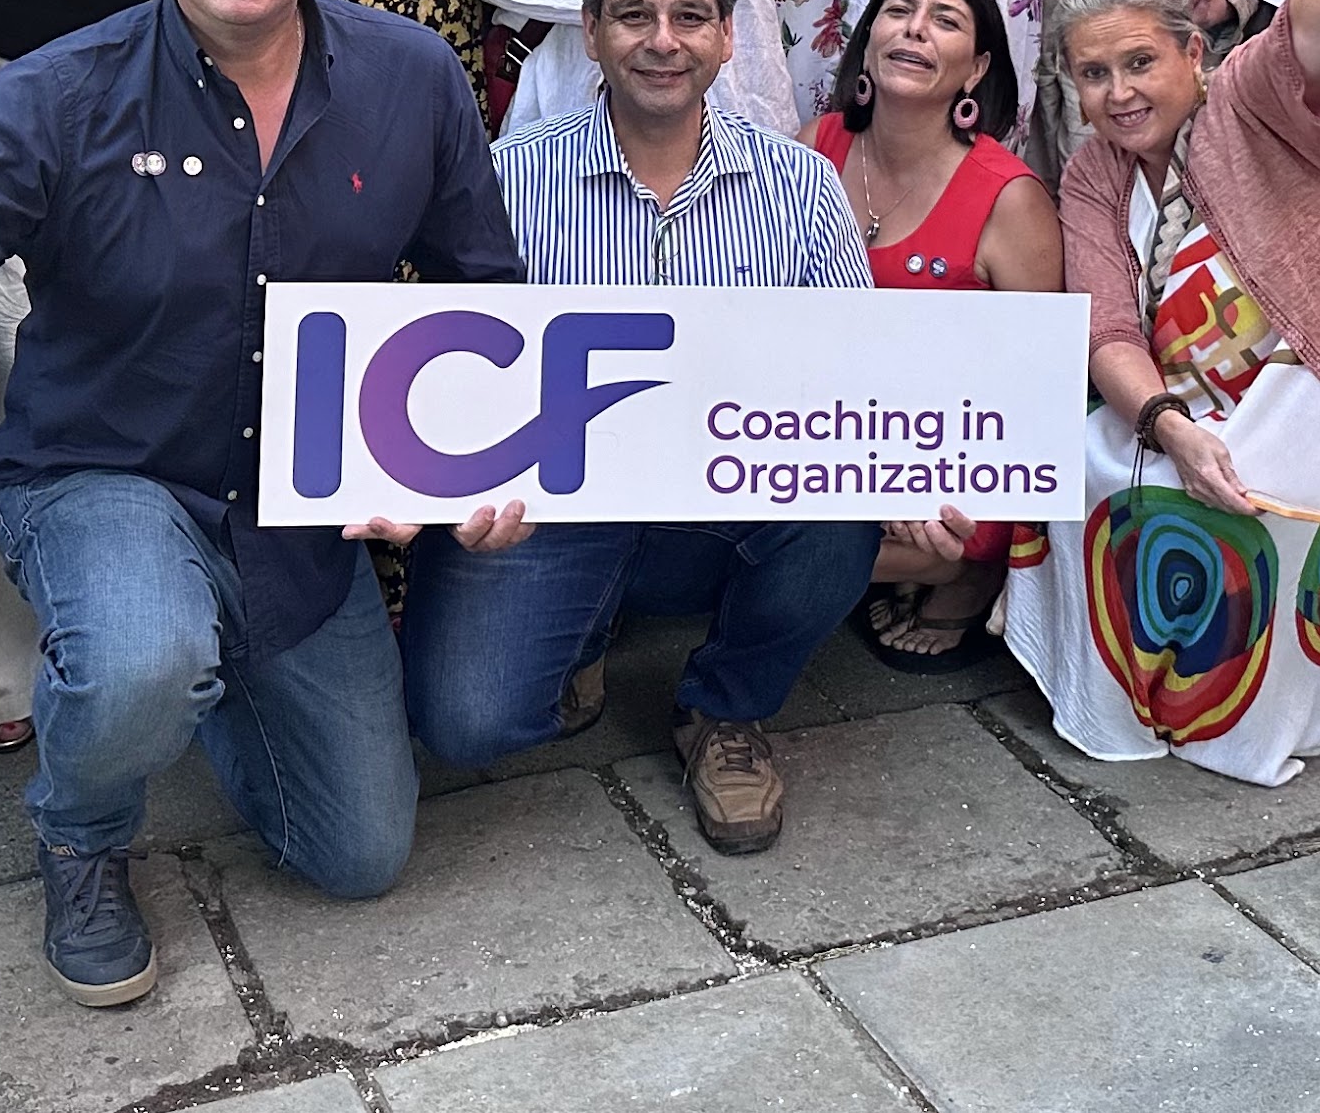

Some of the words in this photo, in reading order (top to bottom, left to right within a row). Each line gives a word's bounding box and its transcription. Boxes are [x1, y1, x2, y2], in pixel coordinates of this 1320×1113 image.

[292, 310, 676, 499] ICF
[707, 399, 945, 450] Coaching
[963, 399, 1006, 441] in
[707, 452, 1058, 503] Organizations
